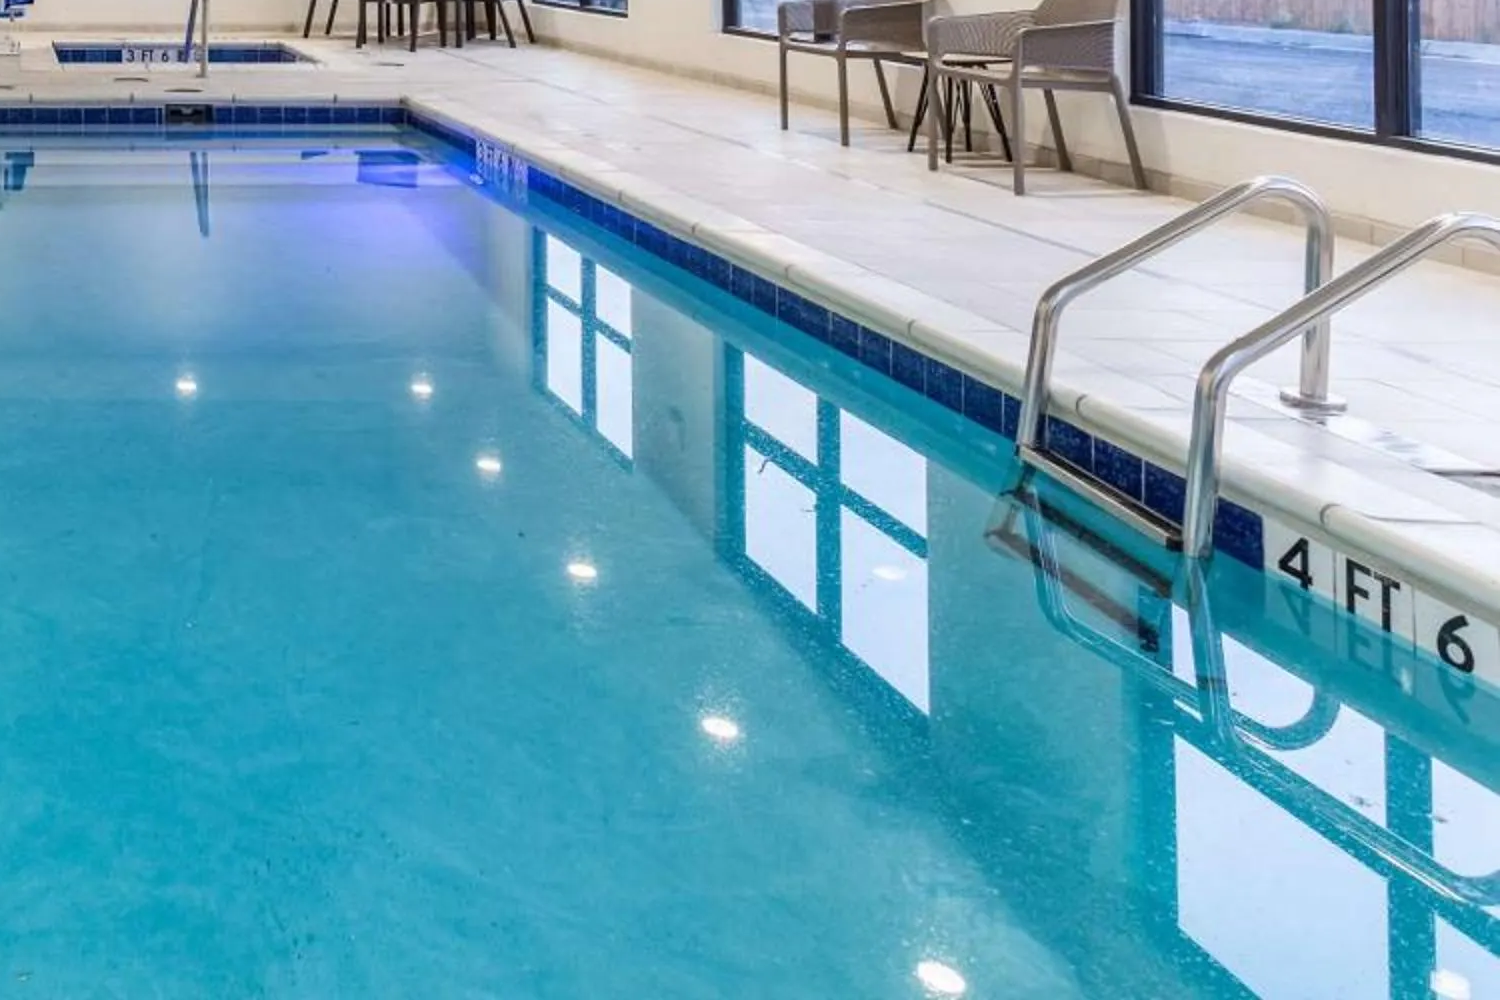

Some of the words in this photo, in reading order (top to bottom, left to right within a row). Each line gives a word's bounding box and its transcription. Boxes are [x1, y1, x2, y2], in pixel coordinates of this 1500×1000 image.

[125, 49, 135, 62] 3
[141, 49, 153, 62] FT
[161, 50, 170, 62] 6
[1278, 537, 1313, 592] 4
[1346, 557, 1401, 633] FT
[1437, 614, 1475, 674] 6
